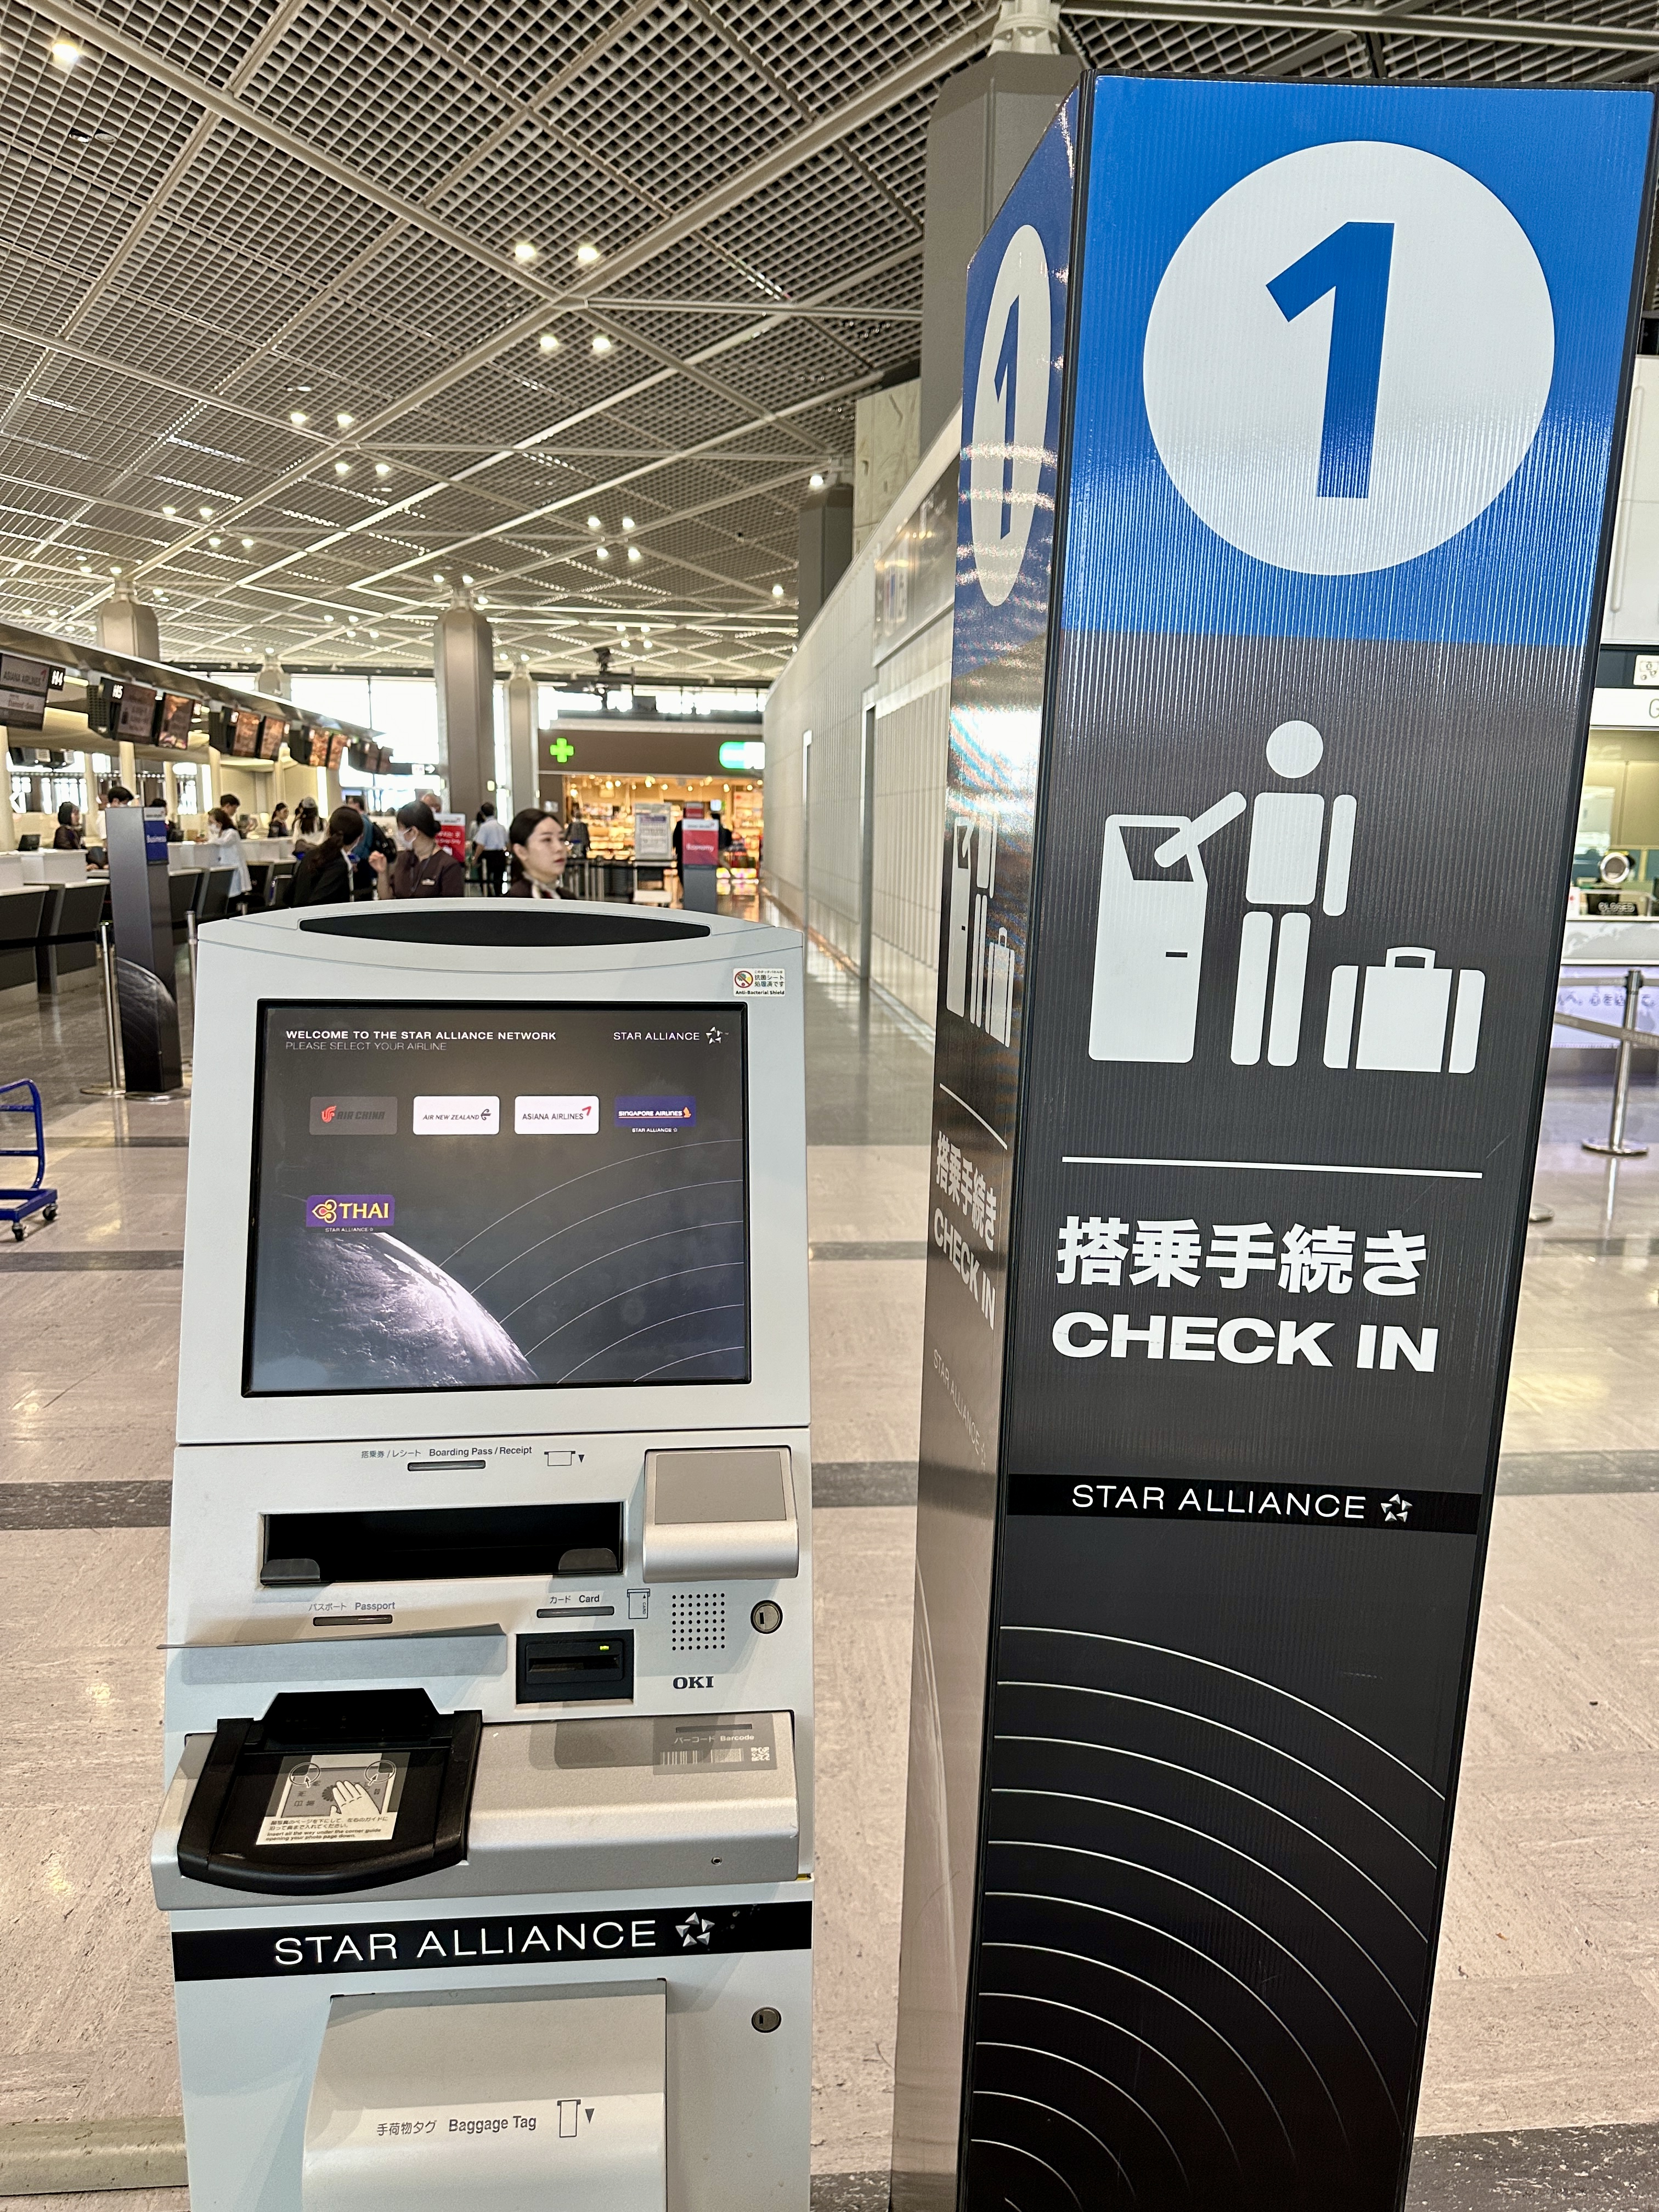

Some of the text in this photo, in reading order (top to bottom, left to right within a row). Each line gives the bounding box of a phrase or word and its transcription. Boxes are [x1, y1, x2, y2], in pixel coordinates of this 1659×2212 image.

[1266, 221, 1395, 499] 1
[994, 294, 1019, 540] 1
[52, 670, 64, 686] H4
[686, 844, 715, 852] Economy
[1598, 902, 1635, 913] CLOSED
[286, 1030, 348, 1039] WELCOME
[353, 1031, 369, 1039] TO
[374, 1031, 397, 1039] THE
[401, 1031, 431, 1040] STAR
[436, 1031, 493, 1040] ALLIANCE
[613, 1032, 699, 1040] STAR ALLIANCE
[286, 1042, 447, 1051] PLEASE SELECT YOUR AIRLINE
[336, 1111, 386, 1120] AIR CHINA
[936, 1130, 997, 1251] 搭乗手続き
[338, 1202, 389, 1219] THAI
[1056, 1215, 1426, 1296] 搭乗手続き
[934, 1207, 996, 1330] CHECK IN
[1052, 1311, 1438, 1373] CHECK IN
[933, 1349, 980, 1455] STAR ALLIANCE
[429, 1448, 469, 1457] Boarding
[472, 1447, 493, 1455] Pass
[500, 1446, 532, 1455] Receipt
[1071, 1485, 1367, 1520] STAR ALLIANCE
[355, 1601, 396, 1611] Passport
[550, 1595, 571, 1604] カード
[579, 1595, 600, 1603] Card
[308, 1602, 347, 1611] パスポート
[673, 1676, 714, 1689] OKI
[674, 1735, 715, 1744] バーコード
[274, 1919, 657, 1966] STAR ALLIANCE
[377, 2119, 438, 2136] 手荷物タグ
[449, 2115, 537, 2134] Baggage Tag
